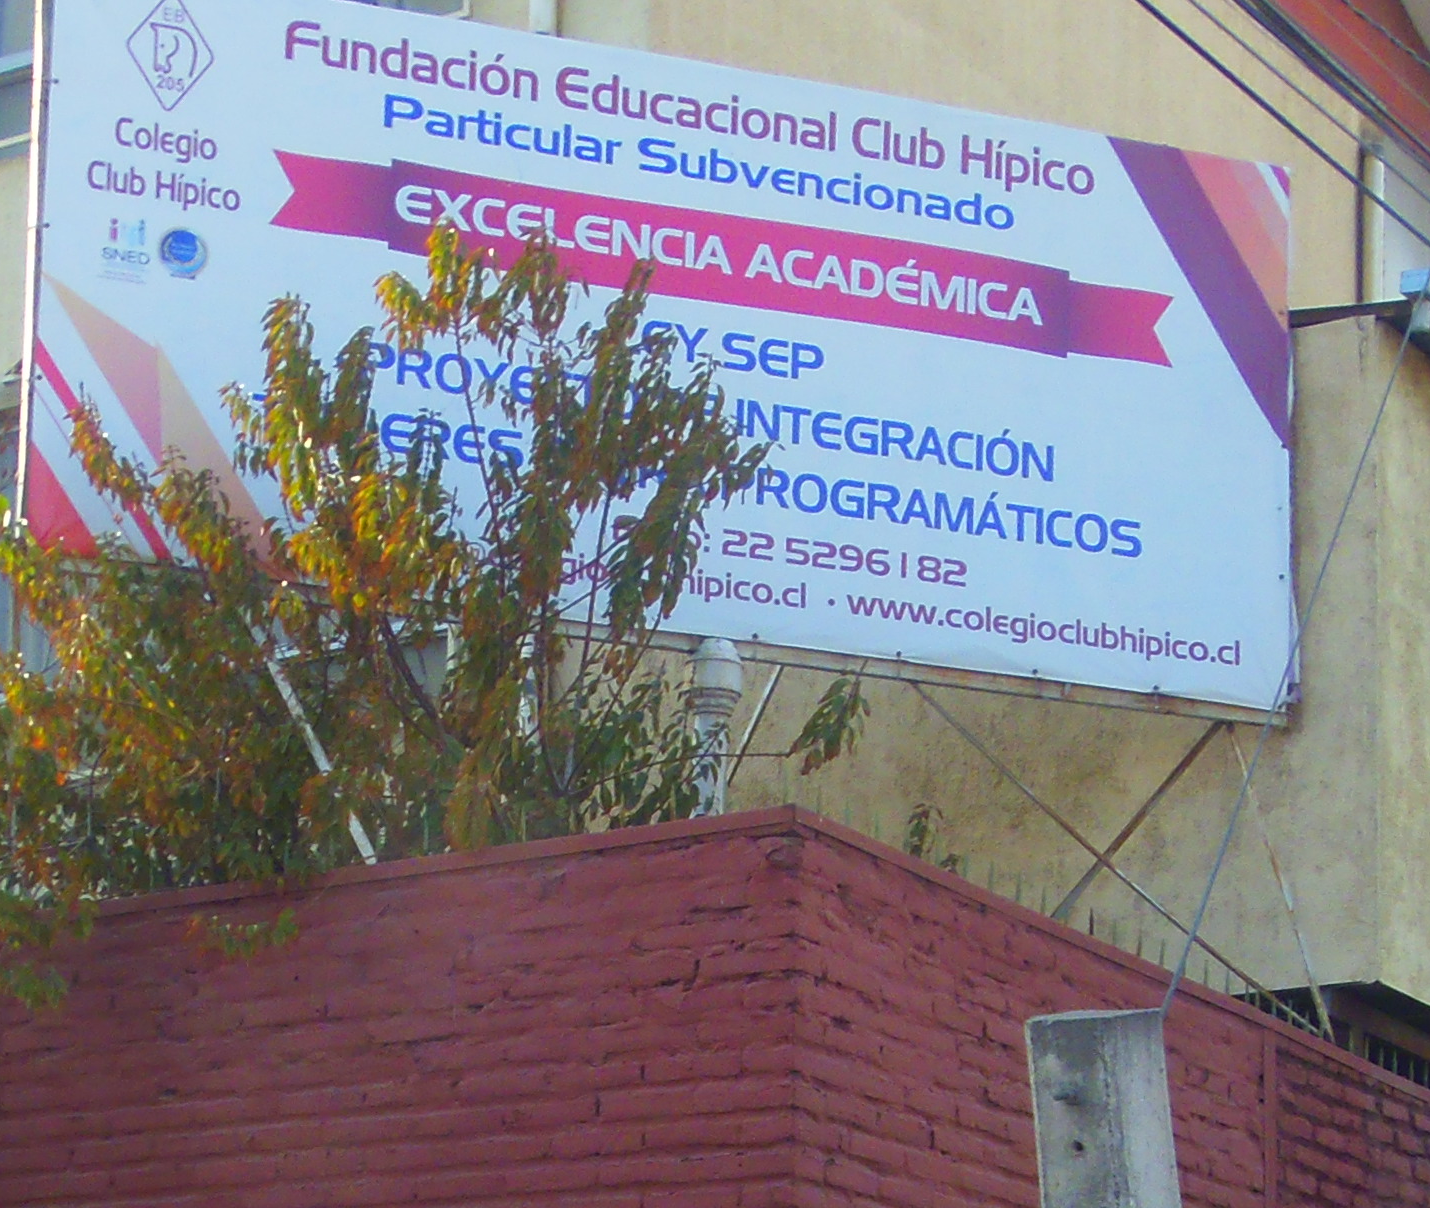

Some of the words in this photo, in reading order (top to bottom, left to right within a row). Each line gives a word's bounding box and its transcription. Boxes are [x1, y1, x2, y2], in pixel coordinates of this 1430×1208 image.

[155, 74, 185, 92] 205
[284, 20, 539, 102] Fundación
[555, 66, 838, 152] Educacional
[851, 116, 945, 170] Club
[960, 134, 1095, 195] Hípico
[115, 117, 218, 163] Colegio
[383, 94, 623, 165] Particular
[638, 136, 1015, 230] Subvencionado
[87, 160, 146, 196] Club
[155, 170, 241, 211] Hípico
[101, 246, 150, 265] SNED
[395, 184, 732, 276] EXCELENCIA
[744, 244, 1043, 325] ACADÉMICA
[721, 332, 825, 380] SEP
[736, 398, 1055, 481] INTEGRACIÓN
[721, 528, 775, 561] 22
[785, 536, 967, 587] 5296182
[847, 591, 1242, 665] www.colegioclubhipico.cl
